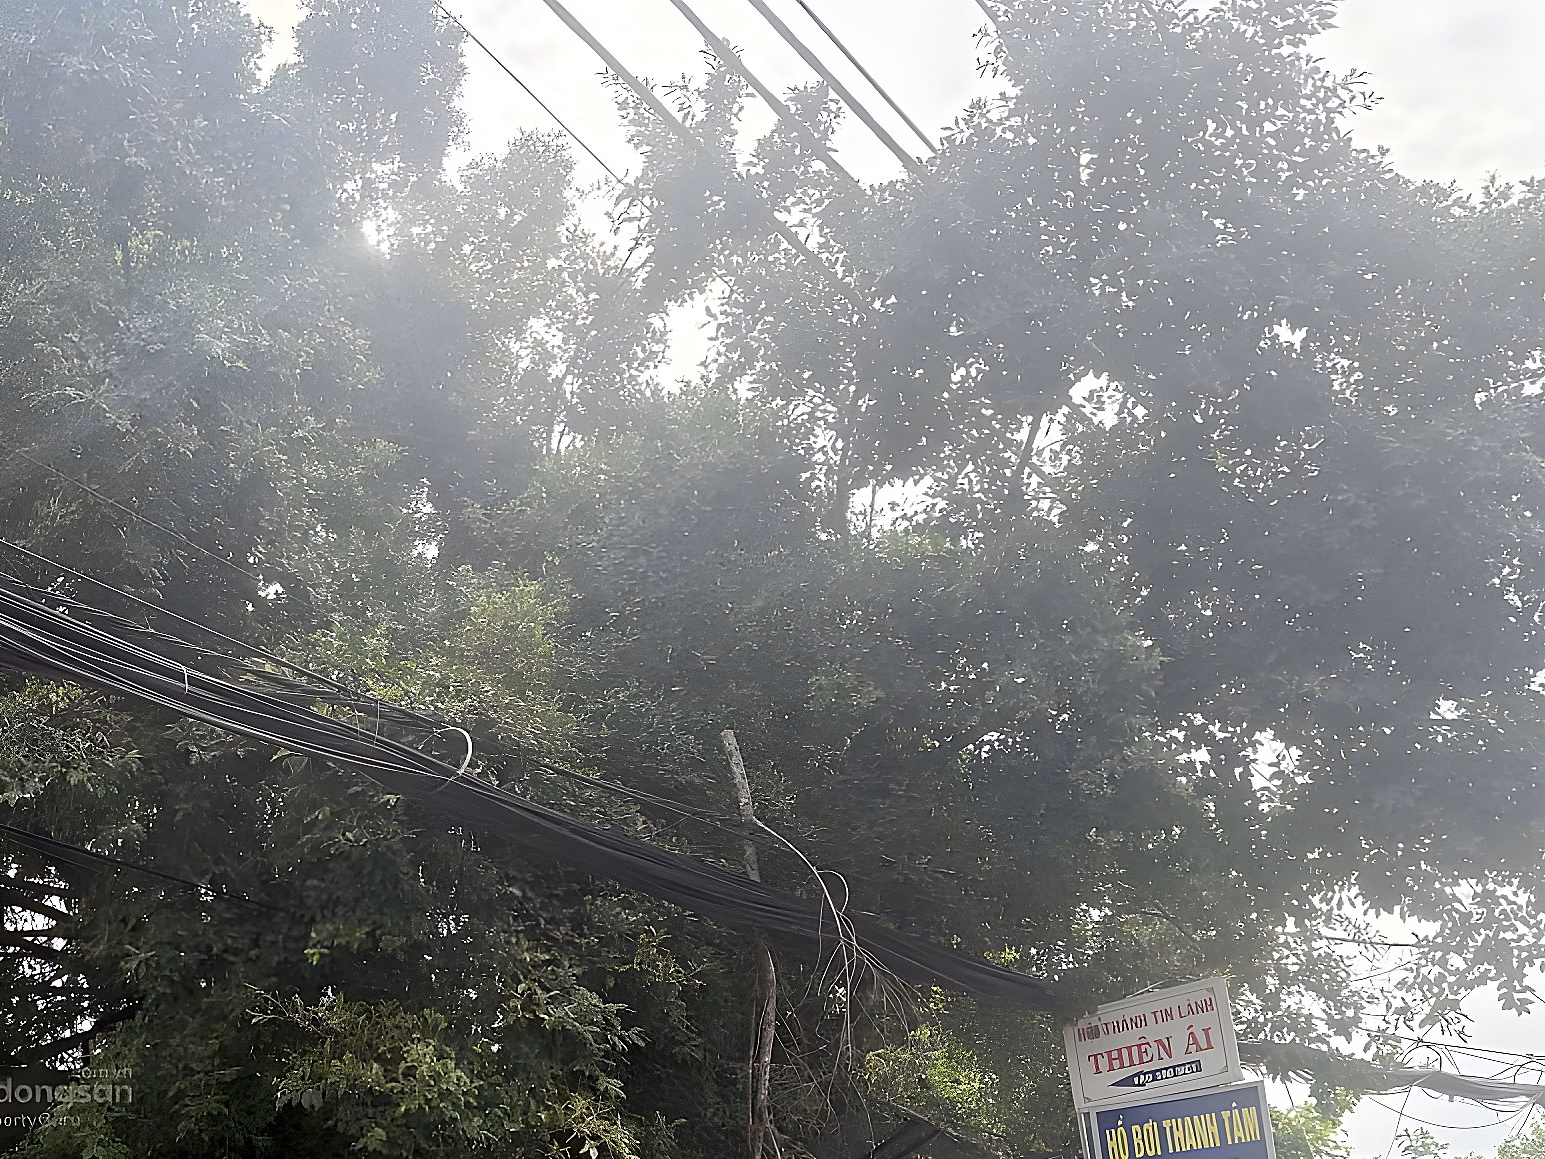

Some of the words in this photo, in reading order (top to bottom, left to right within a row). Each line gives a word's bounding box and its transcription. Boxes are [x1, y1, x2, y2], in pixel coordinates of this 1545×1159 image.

[1101, 1014, 1148, 1036] THÁNH
[1150, 1006, 1174, 1025] TIN
[1087, 1035, 1173, 1075] THIÊN
[1184, 1024, 1215, 1056] ÁI
[1131, 1119, 1162, 1159] BƠI
[1162, 1112, 1221, 1154] THANH
